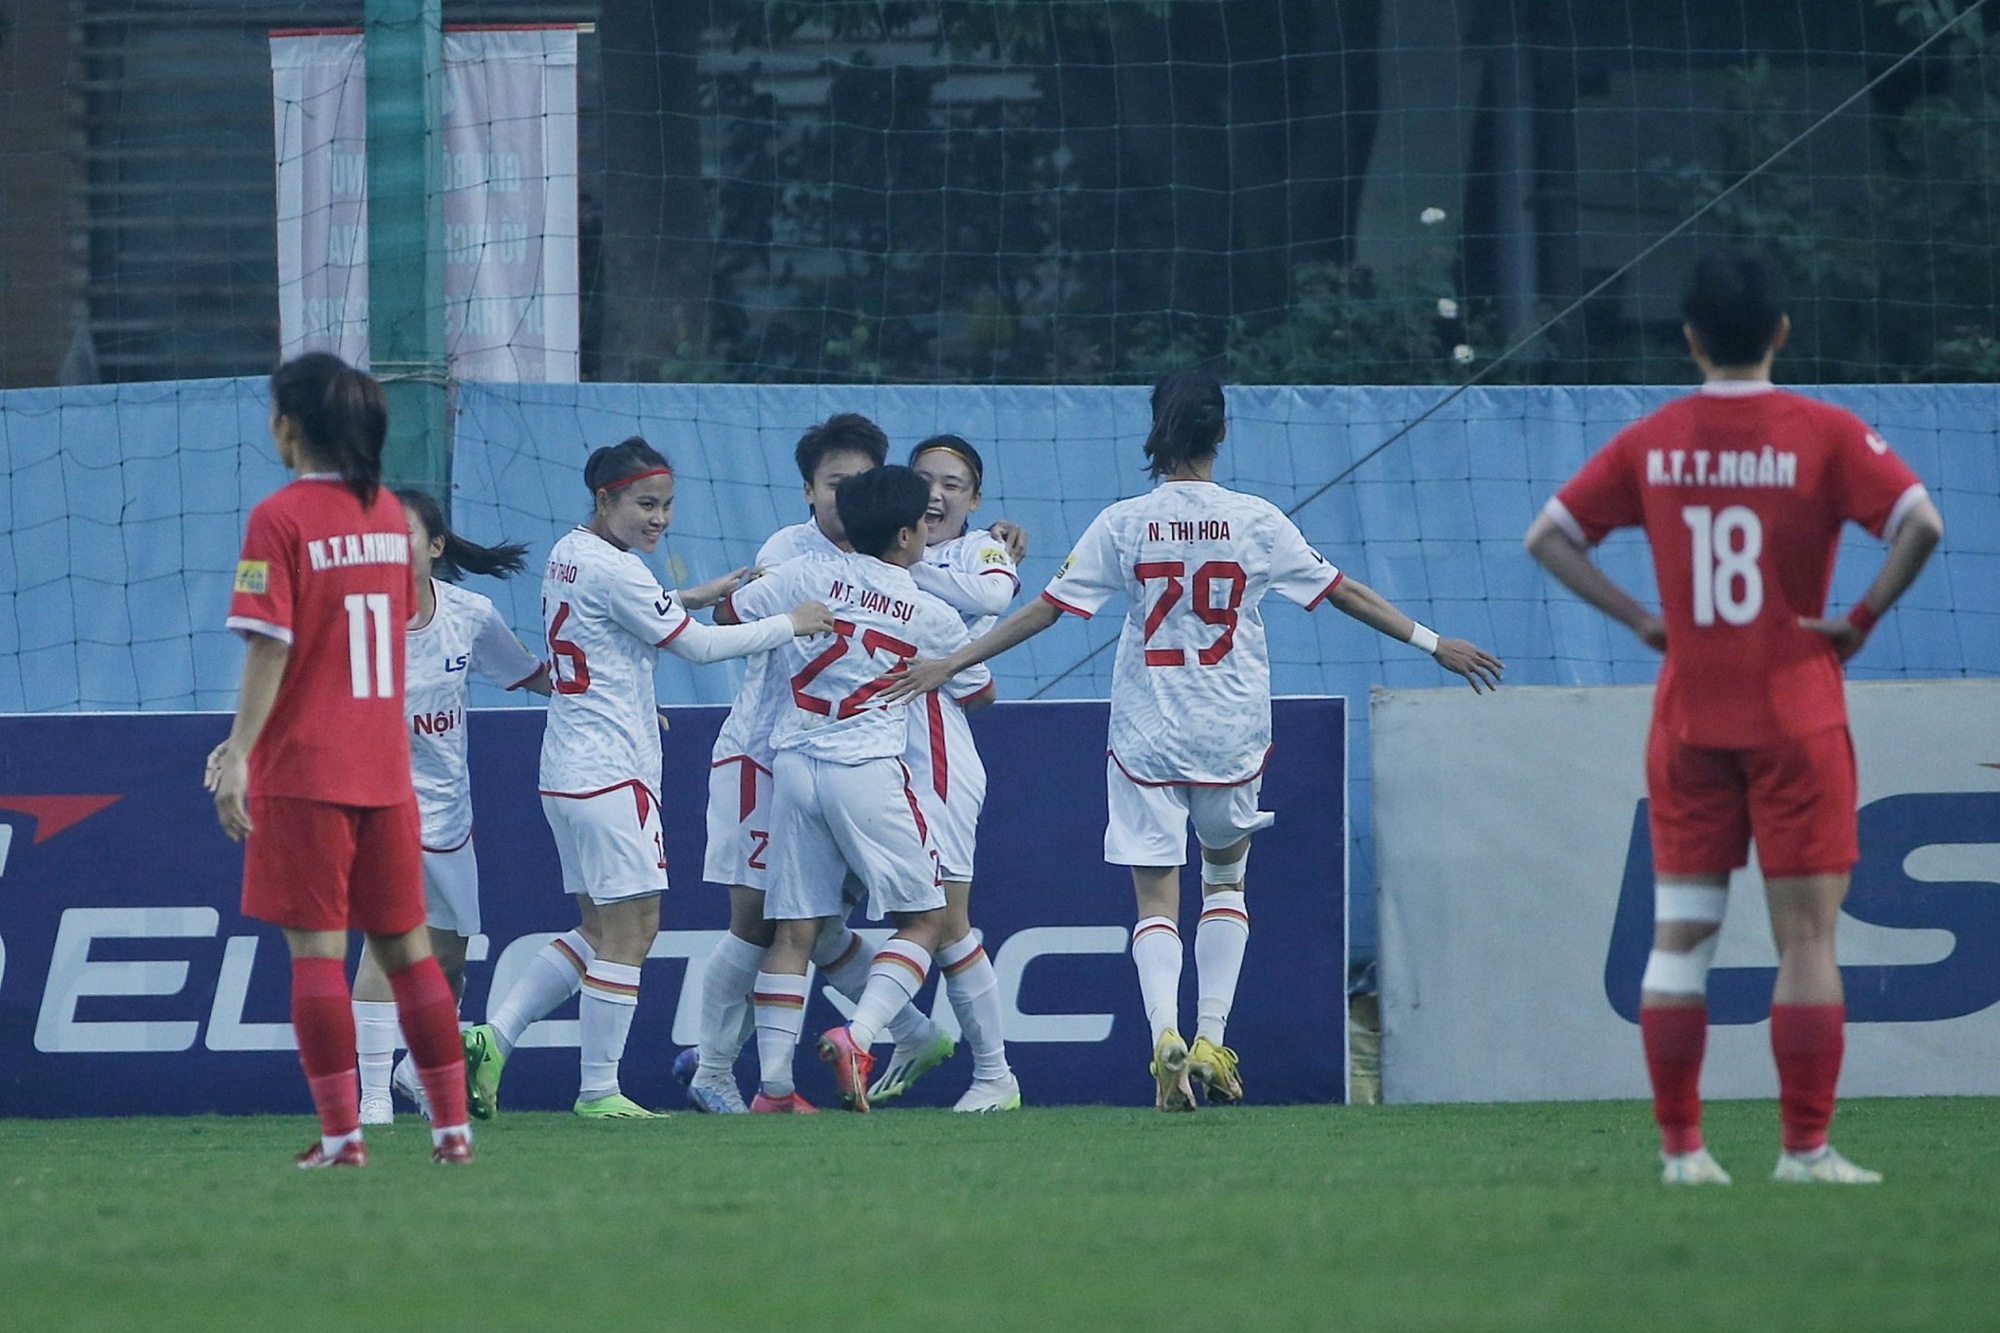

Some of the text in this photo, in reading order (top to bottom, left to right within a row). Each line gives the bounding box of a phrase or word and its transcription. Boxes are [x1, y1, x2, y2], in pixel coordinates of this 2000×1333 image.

[1149, 520, 1230, 544] N. THỊ HOA
[1682, 505, 1764, 626] 18
[344, 594, 394, 698] 11
[543, 597, 591, 695] 6
[1134, 561, 1246, 666] 29
[445, 655, 467, 673] LS
[413, 709, 454, 737] Nội
